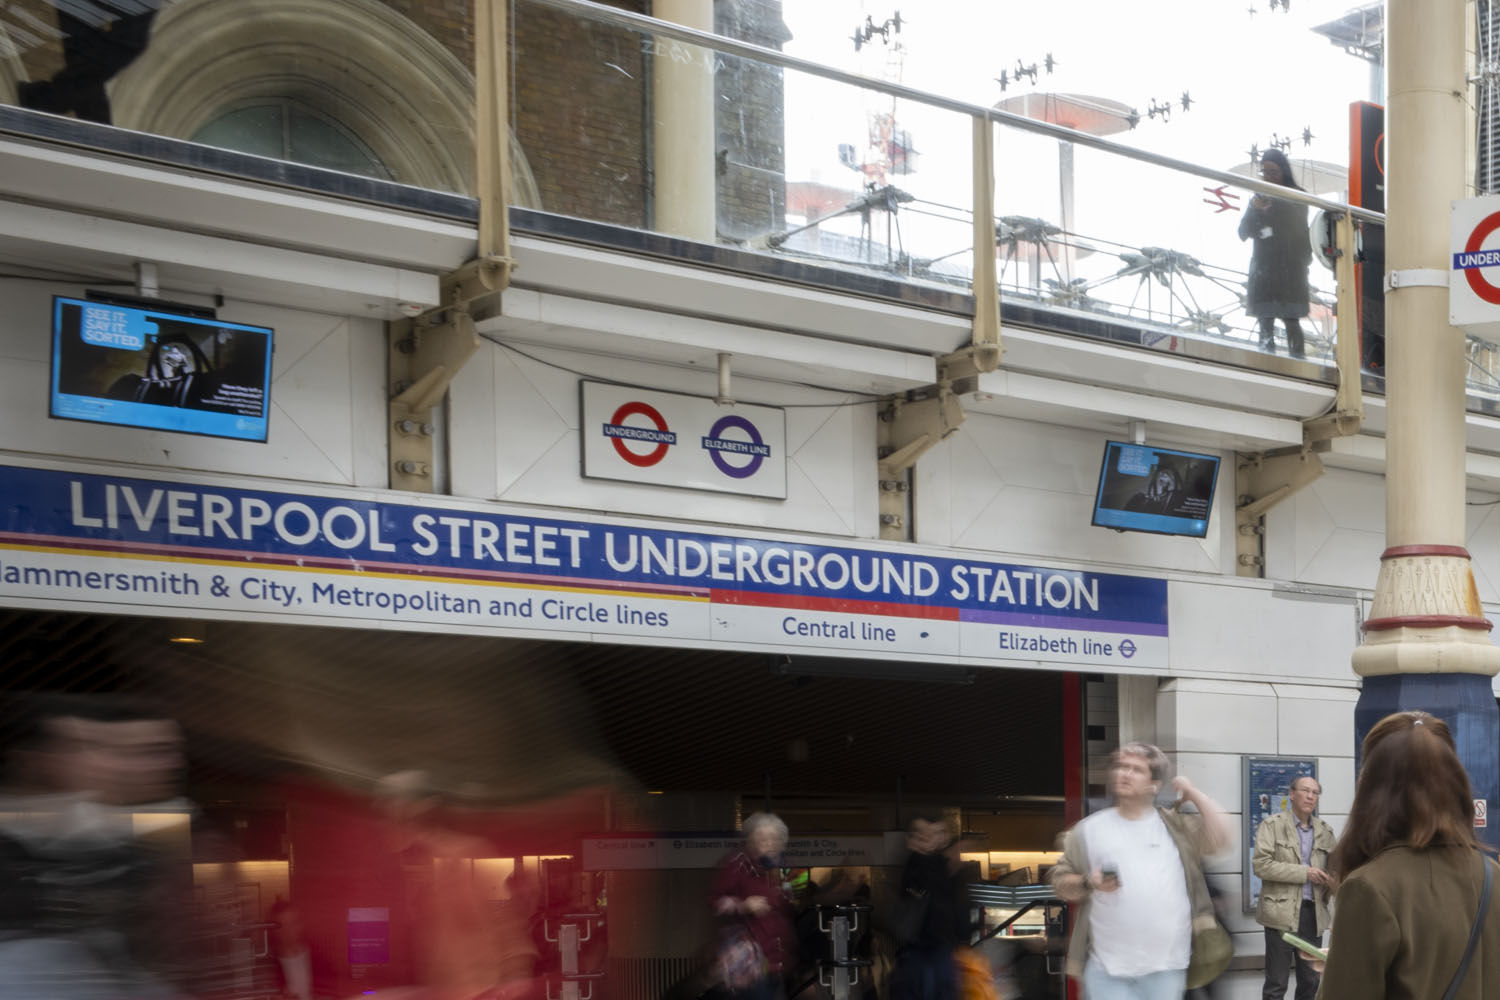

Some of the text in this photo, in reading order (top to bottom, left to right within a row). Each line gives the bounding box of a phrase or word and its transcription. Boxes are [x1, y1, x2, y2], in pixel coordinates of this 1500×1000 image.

[86, 308, 128, 324] SEE IT.
[86, 319, 128, 334] SAY IT.
[86, 330, 143, 348] SORTED.
[604, 426, 675, 443] UNDERGROUND
[704, 439, 769, 455] ELIZABETH LINE
[70, 481, 1099, 611] LIVERPOOL STREET UNDERGROUND STATION
[0, 560, 669, 627] ammersmith & City, Metropolitan and Circle lines
[782, 616, 896, 642] Central line
[1000, 632, 1113, 656] Elizabeth line
